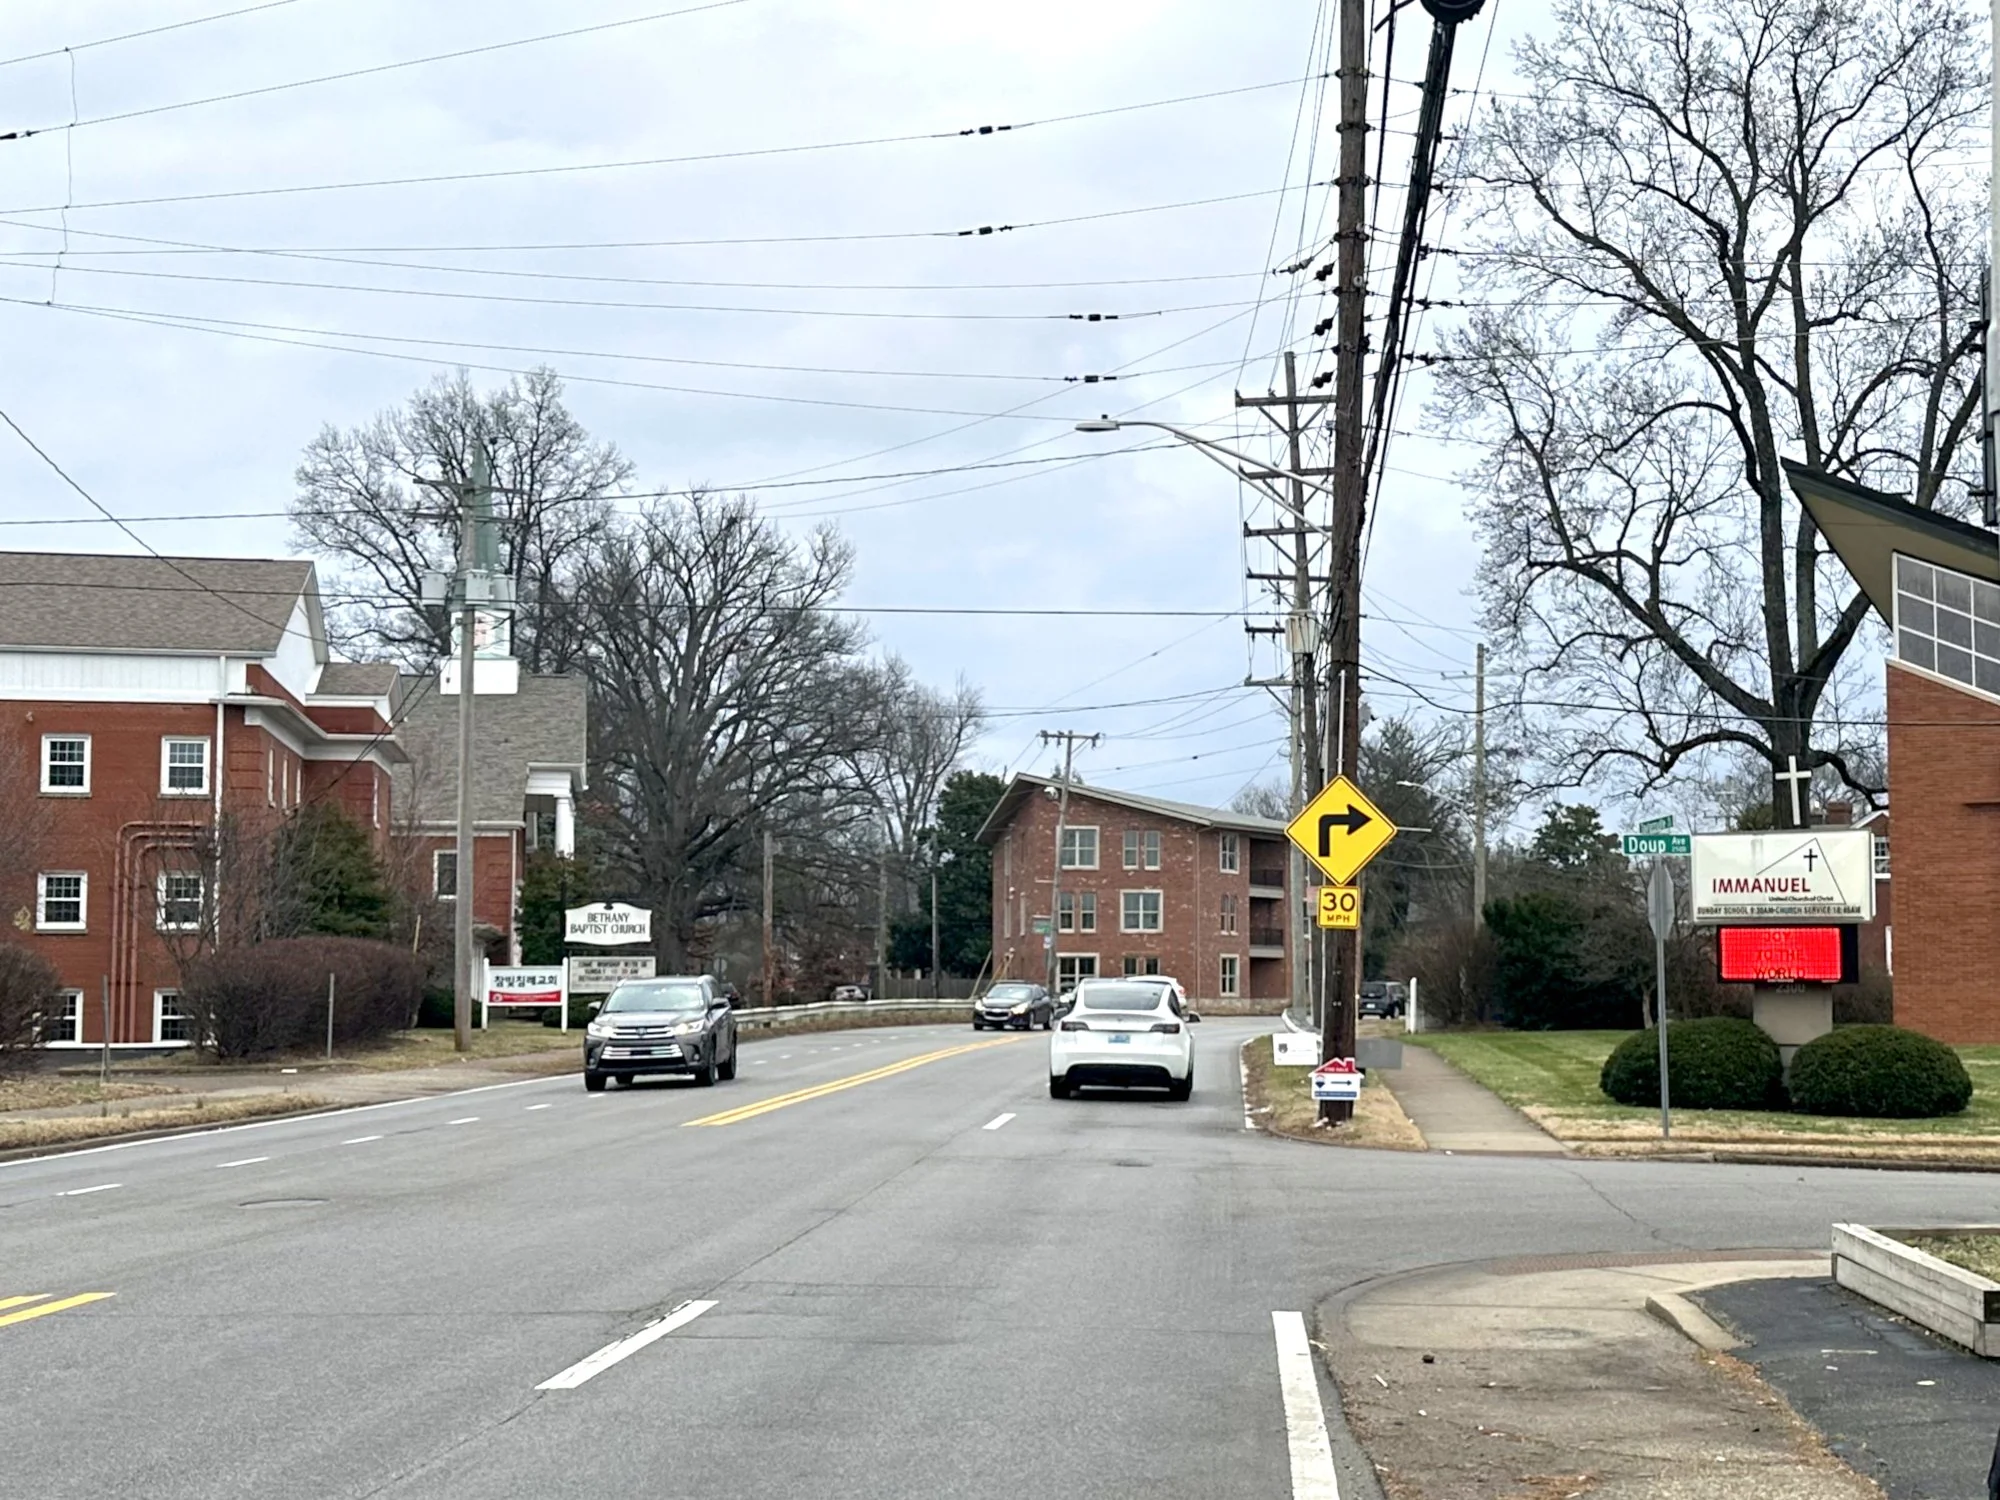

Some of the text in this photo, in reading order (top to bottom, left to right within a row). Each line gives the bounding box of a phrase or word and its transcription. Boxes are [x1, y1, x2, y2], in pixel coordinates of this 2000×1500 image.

[1628, 836, 1686, 855] Doup Ave
[1712, 878, 1811, 893] IMMANUEL
[1322, 892, 1356, 912] 30
[1697, 906, 1722, 915] SUNDAY
[1724, 906, 1749, 915] SCHOOL
[587, 912, 630, 923] BETHANY
[1327, 914, 1350, 923] MPH
[570, 923, 646, 934] BAPTIST CHURCH
[1764, 931, 1791, 942] JOY
[1757, 949, 1805, 961] TO THE
[1753, 967, 1806, 979] WORLD
[494, 975, 558, 988] 참빛침례교회
